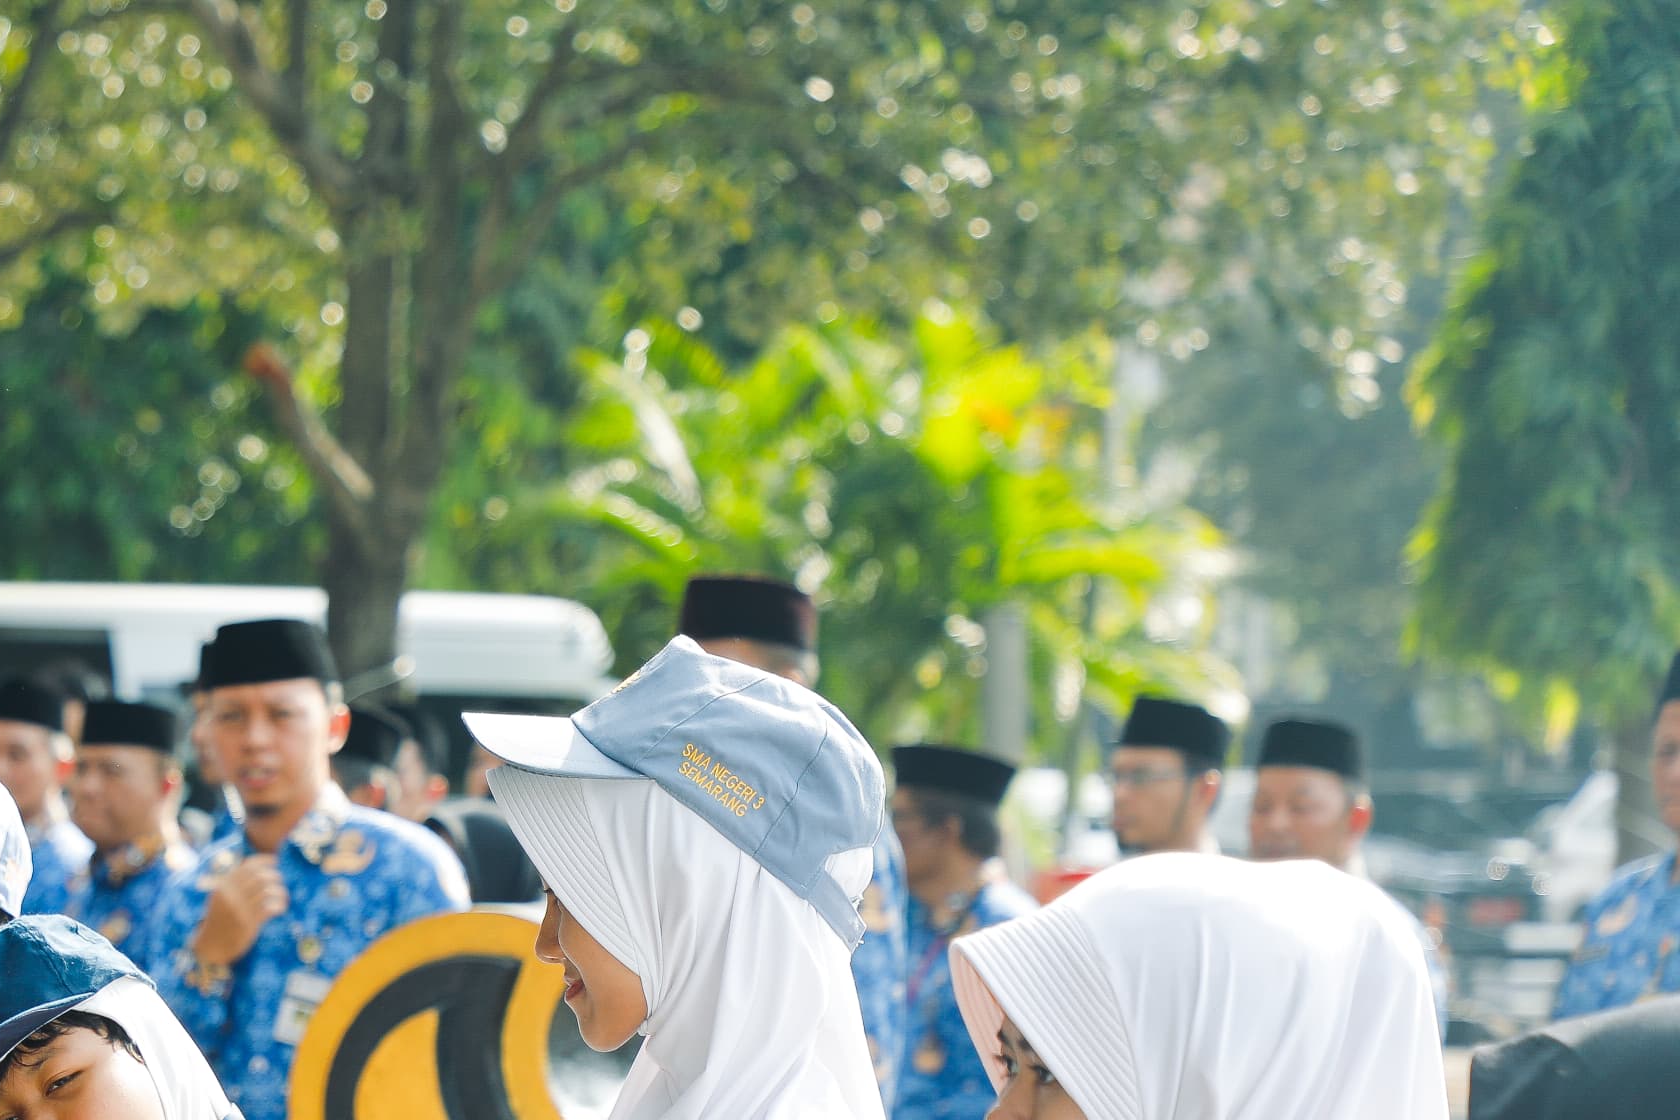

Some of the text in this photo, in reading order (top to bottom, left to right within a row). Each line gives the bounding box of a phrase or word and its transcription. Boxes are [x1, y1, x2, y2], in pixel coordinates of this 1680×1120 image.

[678, 761, 747, 816] SEMARANG
[683, 743, 765, 810] SMA NEGERI 3
